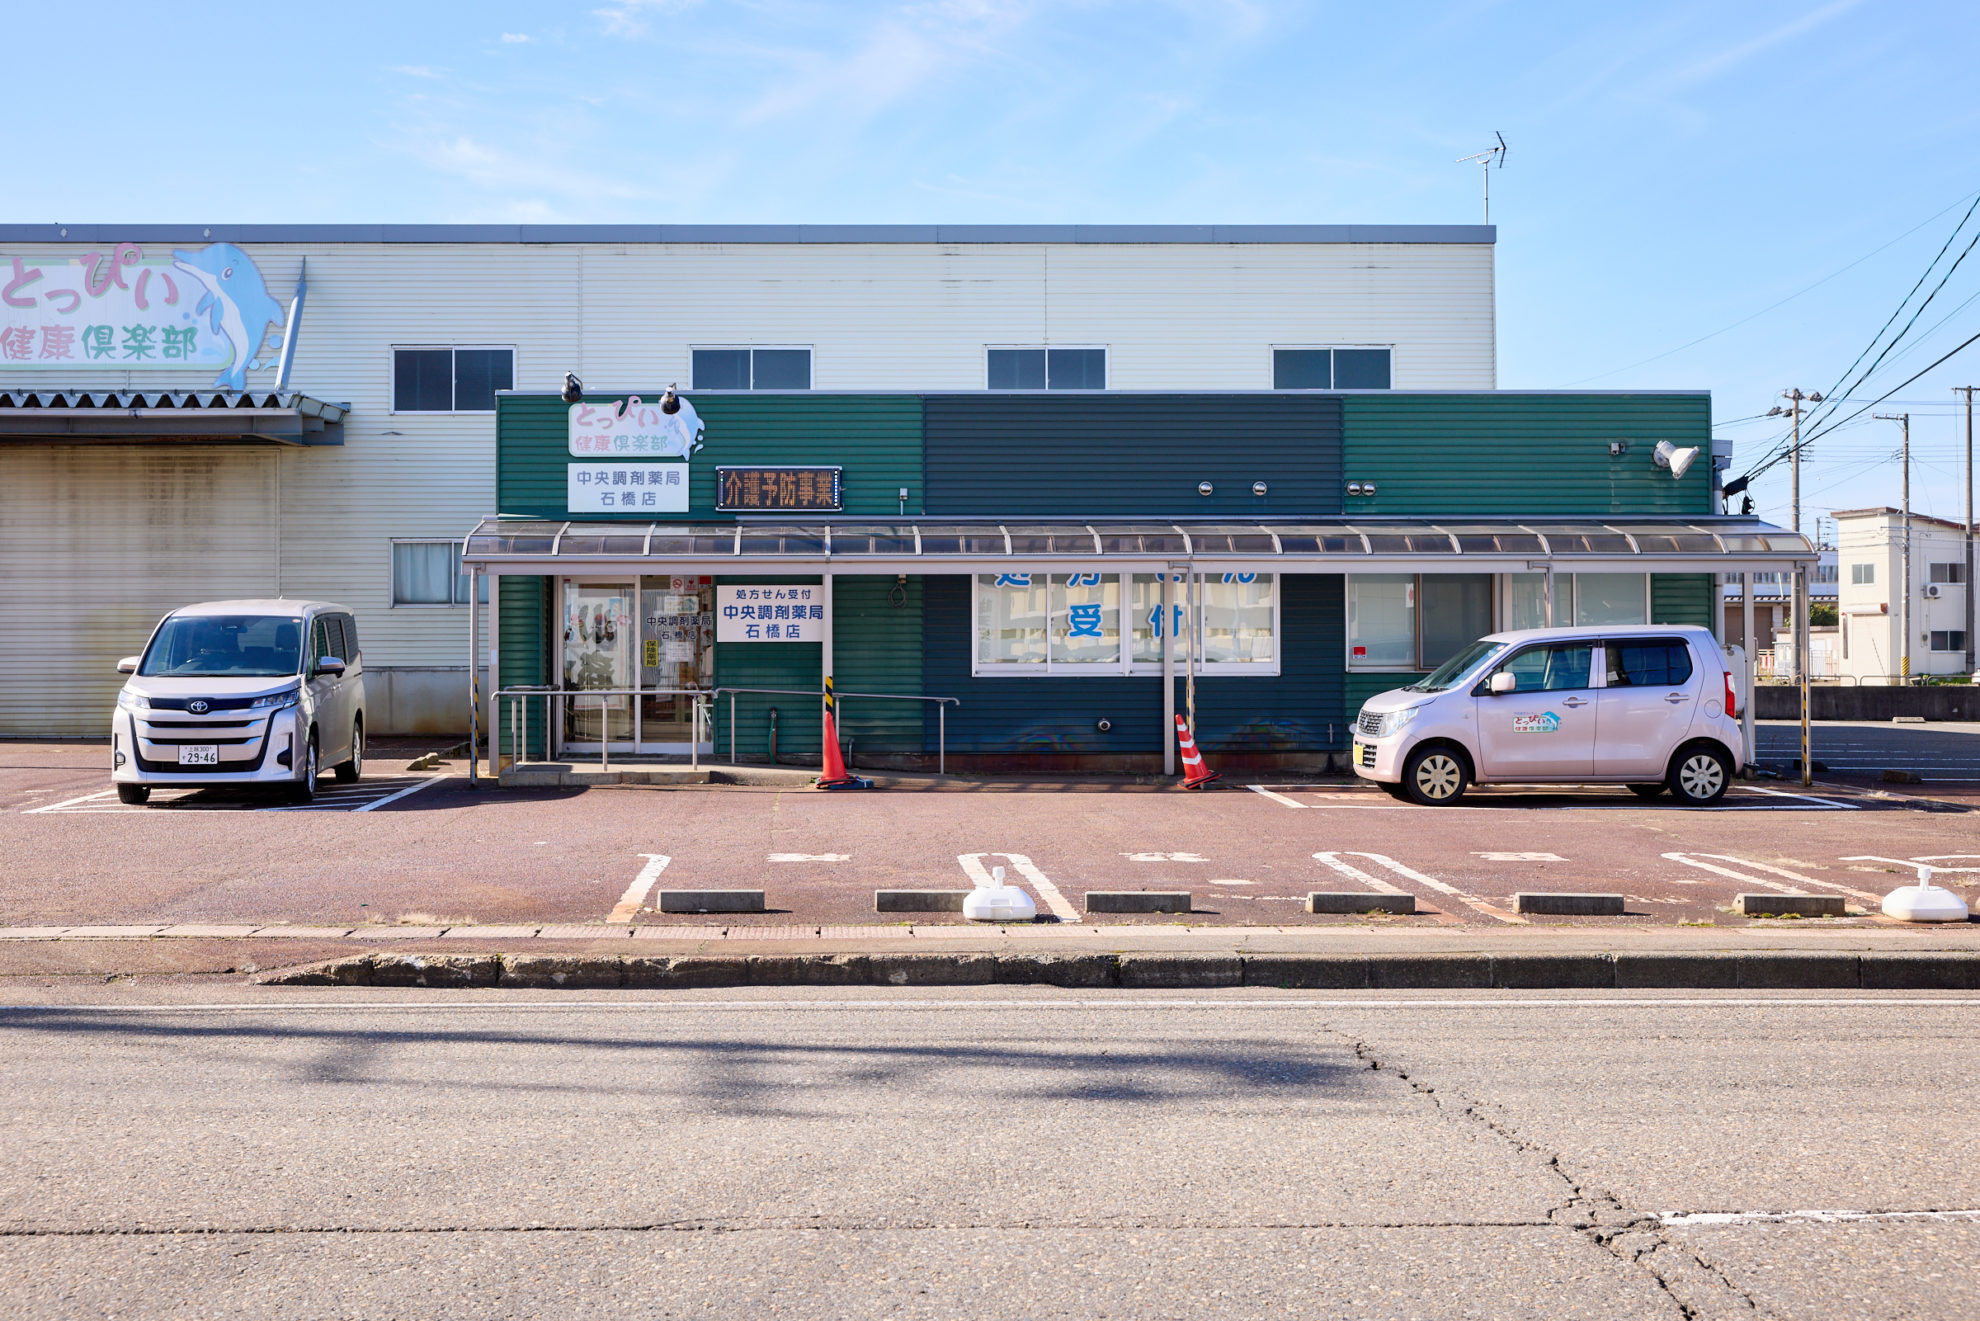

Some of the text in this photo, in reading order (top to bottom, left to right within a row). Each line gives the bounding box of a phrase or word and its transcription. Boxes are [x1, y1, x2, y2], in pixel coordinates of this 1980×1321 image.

[1, 242, 180, 312] とっぴい
[0, 323, 199, 361] 健康倶楽部
[575, 395, 660, 430] とっぴい
[575, 434, 668, 453] 健康倶楽部
[576, 470, 681, 486] 中央調剤薬局
[725, 471, 833, 507] 介護予防事業
[600, 491, 657, 507] 石橋店
[735, 589, 812, 600] 処方せん受付
[723, 604, 824, 621] 中央調剤薬局
[646, 616, 712, 627] 中央調剤薬局
[745, 624, 801, 639] 石橋店
[187, 752, 216, 763] 29-46
